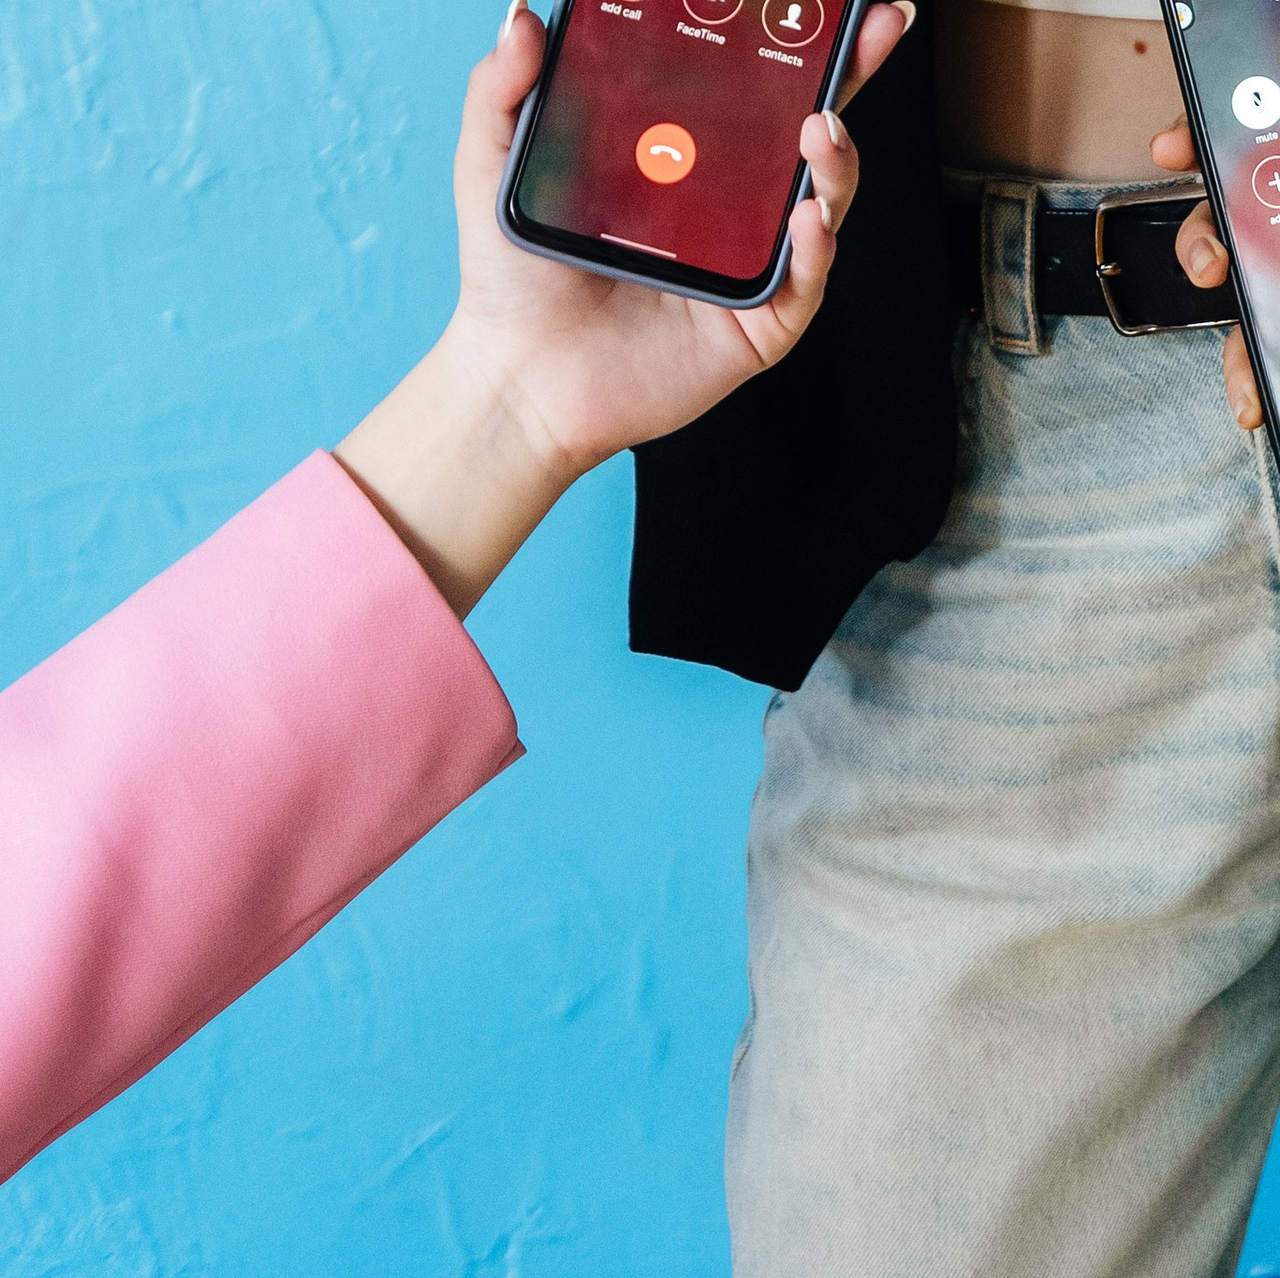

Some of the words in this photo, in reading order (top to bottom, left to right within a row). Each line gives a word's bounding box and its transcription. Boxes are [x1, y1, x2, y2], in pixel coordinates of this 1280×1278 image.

[600, 1, 622, 16] add
[622, 7, 642, 21] call
[676, 21, 726, 45] FaceTime
[758, 46, 804, 68] contacts
[1255, 131, 1279, 144] mute
